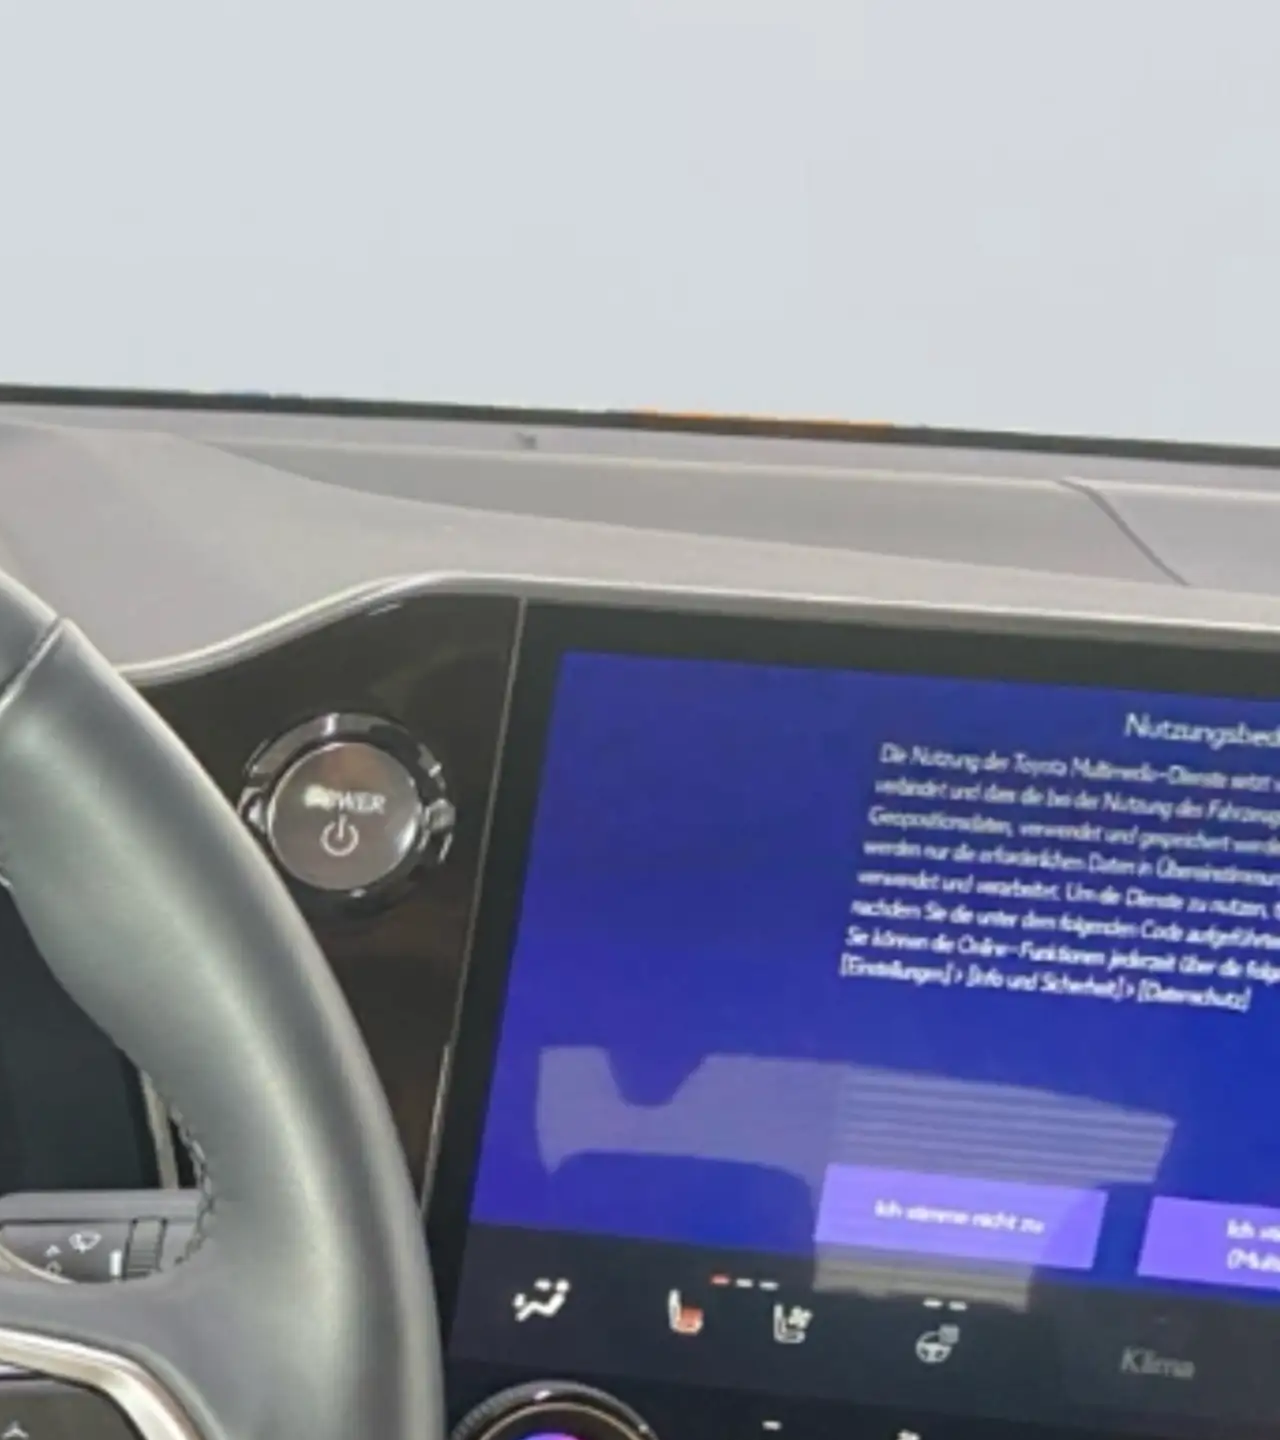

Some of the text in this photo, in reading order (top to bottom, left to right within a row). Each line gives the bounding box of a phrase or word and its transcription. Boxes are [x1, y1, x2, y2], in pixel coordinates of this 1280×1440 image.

[911, 745, 980, 775] Nutzung
[1013, 752, 1068, 778] Toyota
[949, 783, 982, 802] und
[1101, 791, 1174, 822] Nutzung
[1103, 824, 1138, 845] und
[1088, 851, 1135, 875] Daten
[942, 873, 974, 894] und
[1125, 885, 1184, 912] Dienste
[844, 925, 870, 947] Sie
[870, 927, 929, 949] können
[923, 900, 948, 922] Sie
[1058, 912, 1140, 939] folgenden
[1141, 918, 1184, 943] Code
[972, 1211, 1017, 1231] nicht
[1120, 1347, 1195, 1380] Klima
